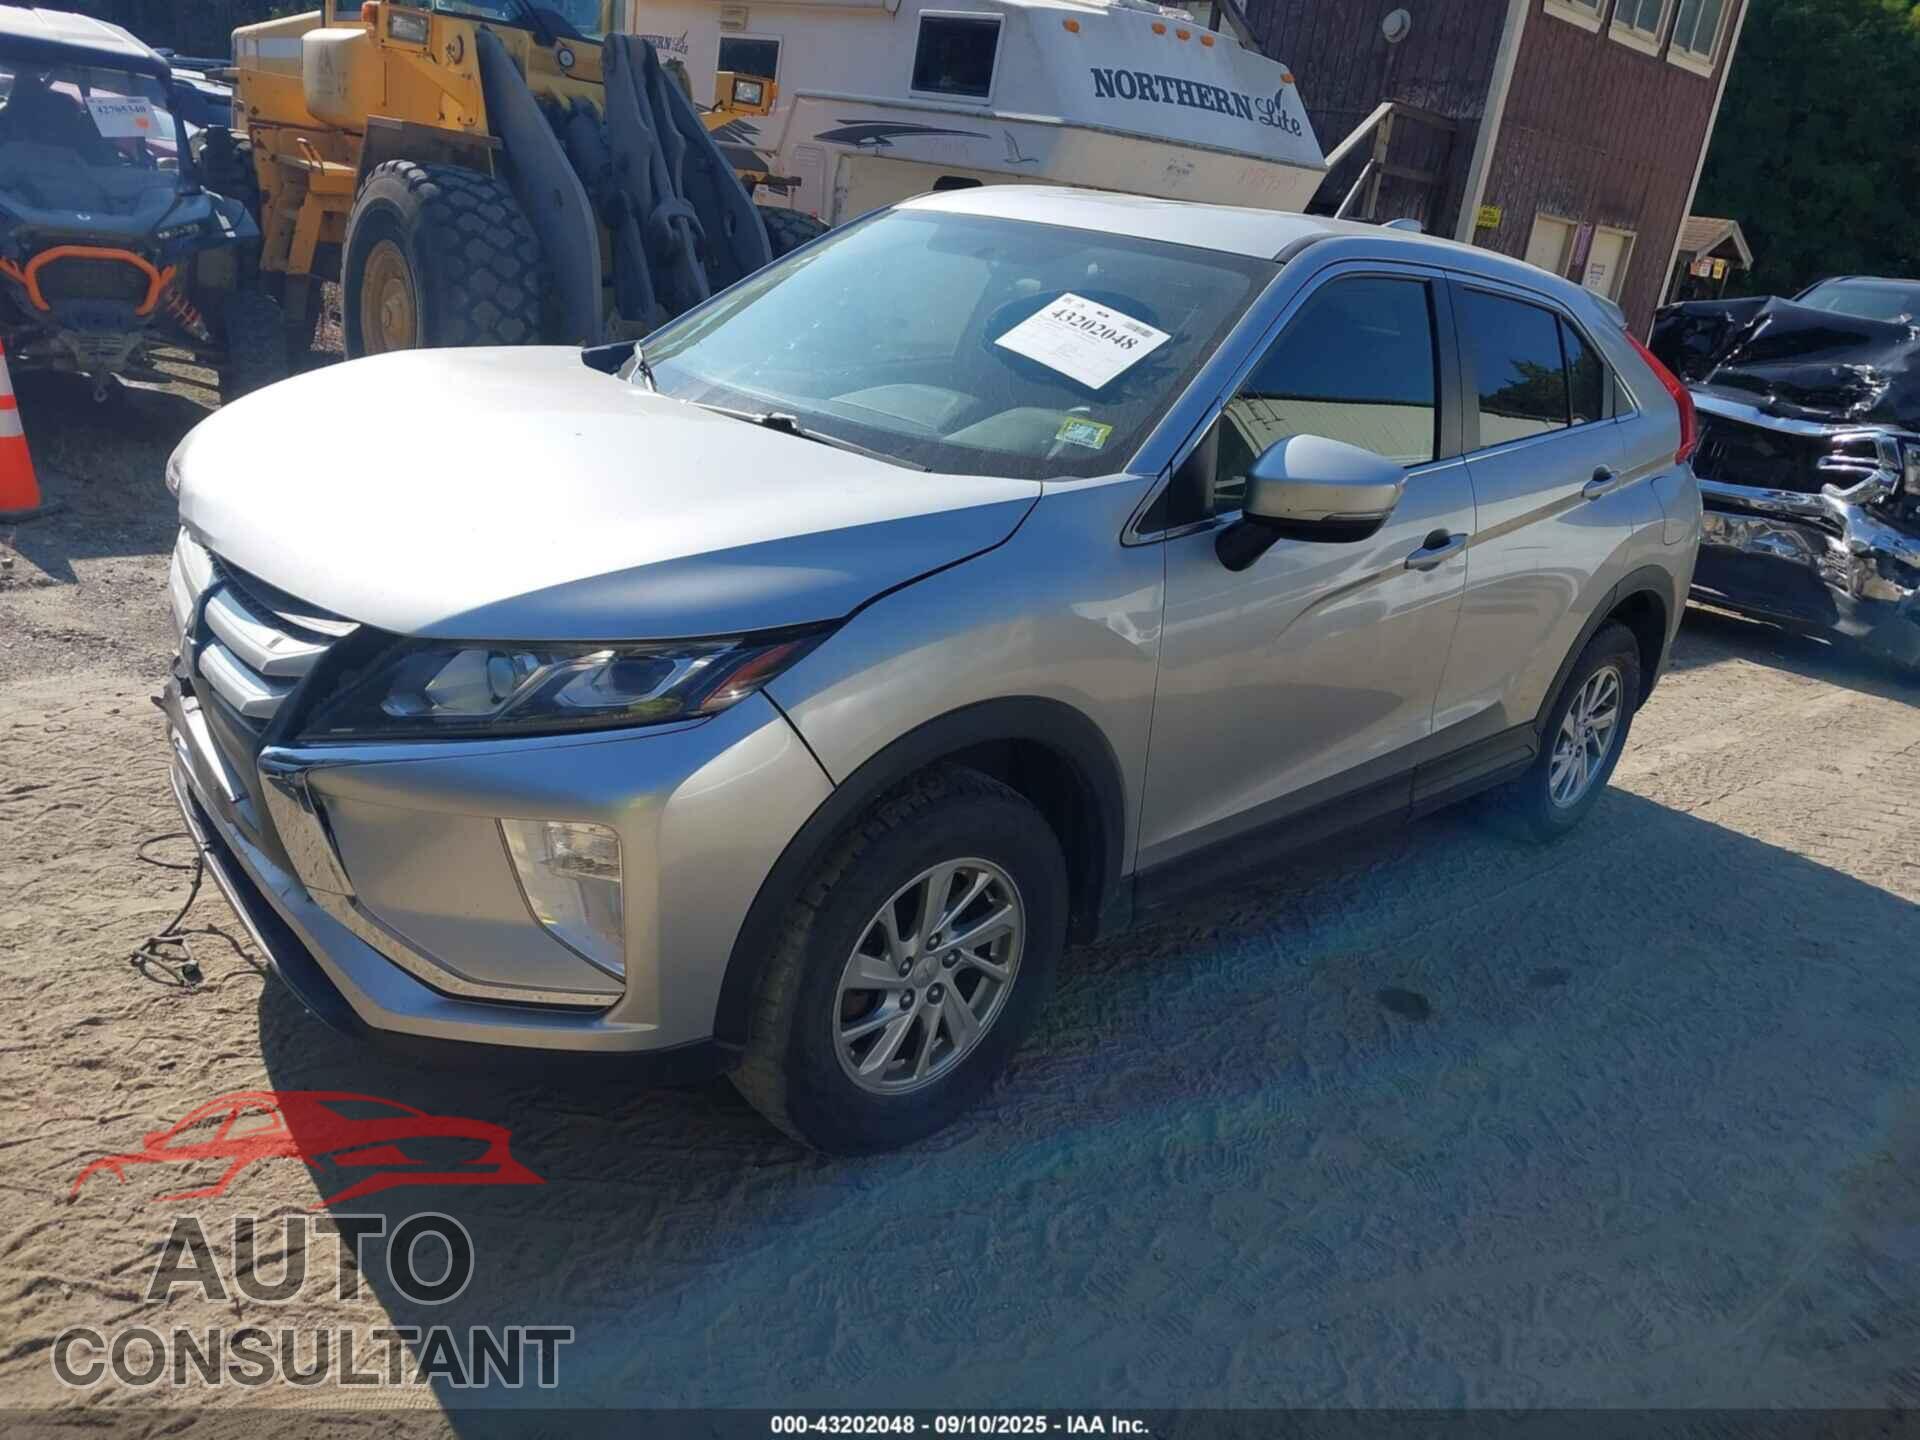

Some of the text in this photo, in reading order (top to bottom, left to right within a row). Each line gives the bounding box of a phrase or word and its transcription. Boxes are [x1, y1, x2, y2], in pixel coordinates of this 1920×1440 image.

[1090, 68, 1303, 137] NORTHERN Lite
[1052, 309, 1139, 350] 43202048
